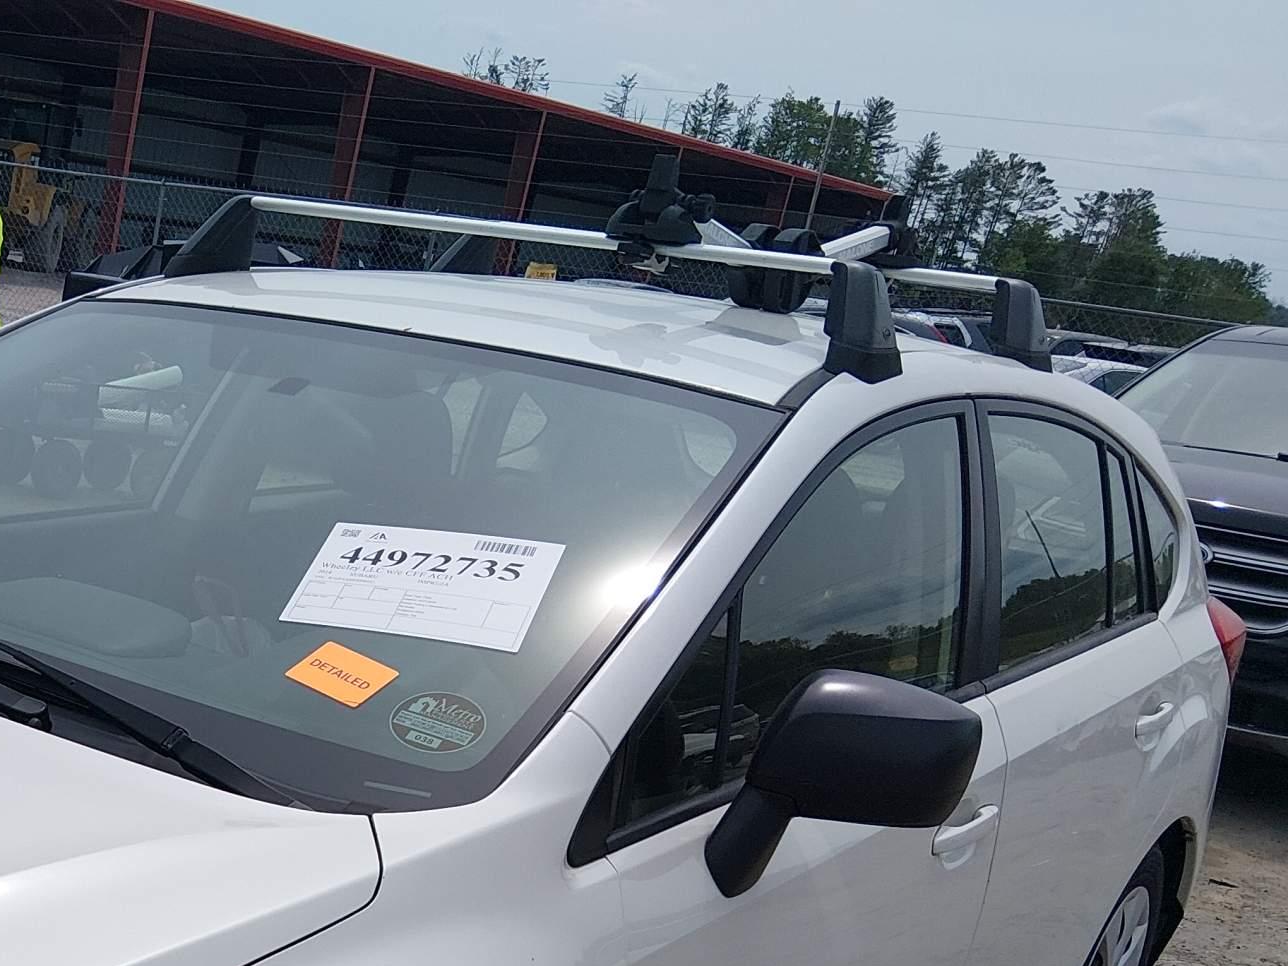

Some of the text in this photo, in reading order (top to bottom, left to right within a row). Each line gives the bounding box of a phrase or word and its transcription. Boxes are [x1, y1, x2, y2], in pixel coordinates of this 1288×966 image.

[339, 546, 525, 583] 44972735
[309, 658, 371, 690] DETAILED
[414, 734, 434, 745] 038
